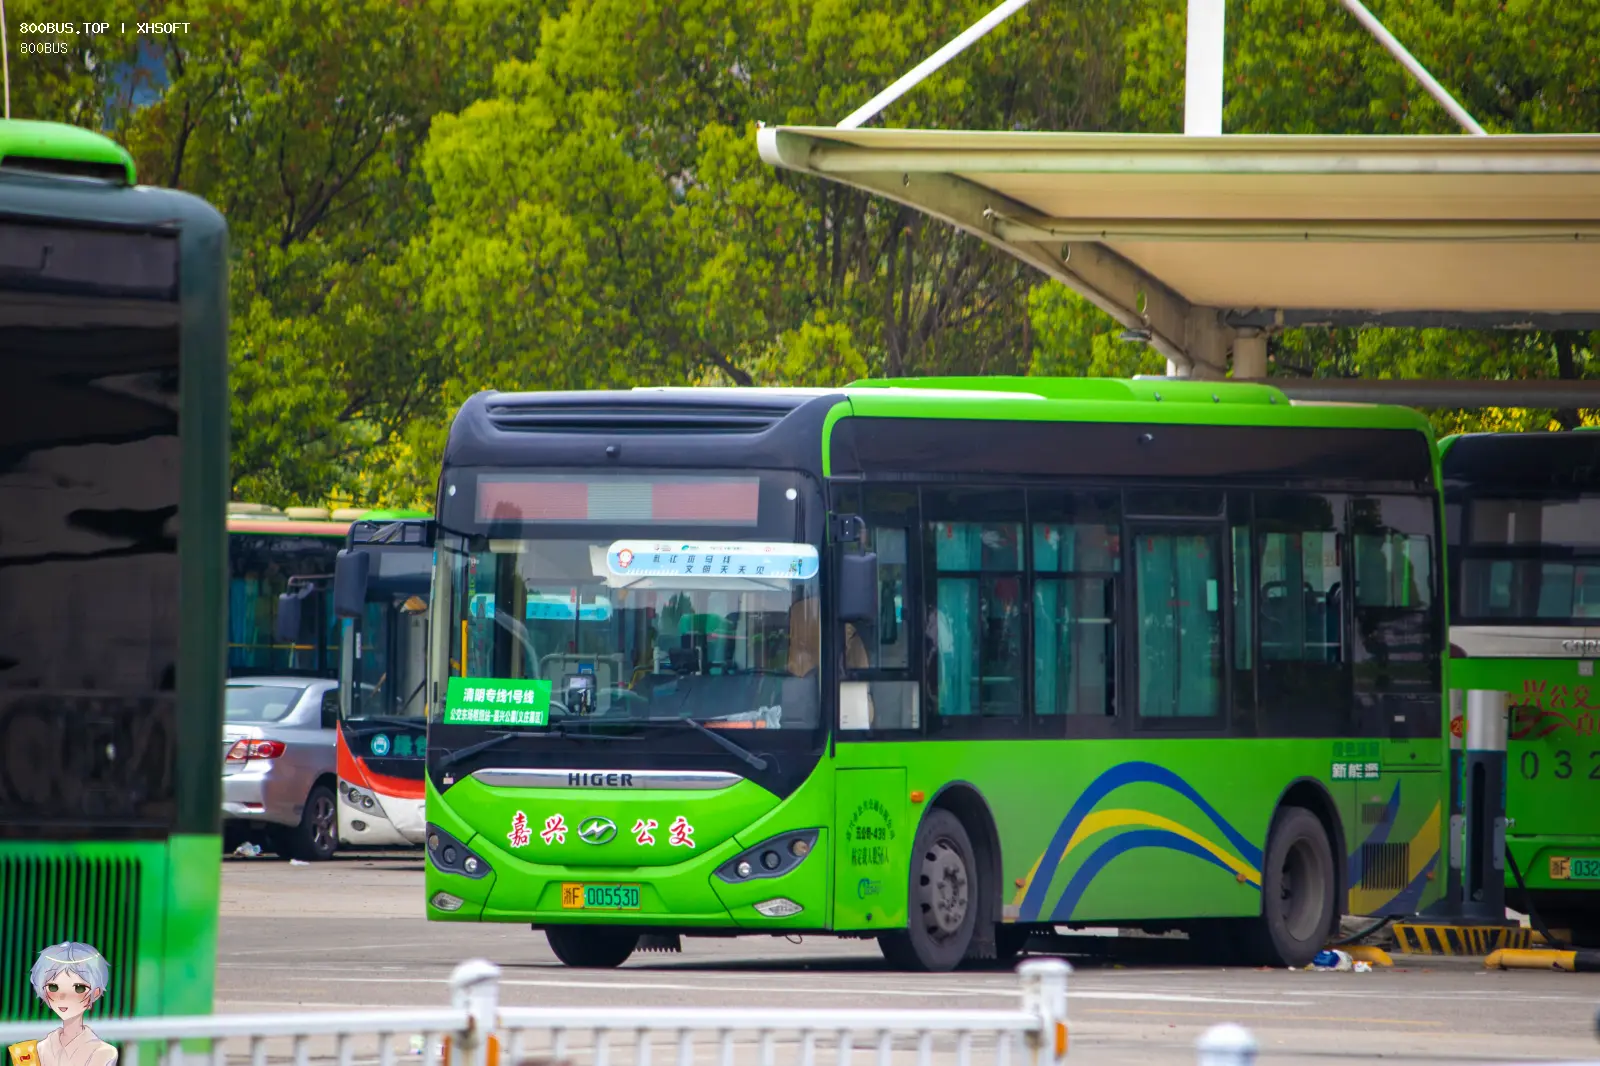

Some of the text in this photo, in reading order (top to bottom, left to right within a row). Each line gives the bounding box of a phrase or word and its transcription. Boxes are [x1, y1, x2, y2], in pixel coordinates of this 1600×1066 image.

[463, 687, 535, 705] 清明专线1号线
[1332, 763, 1379, 778] 新能源
[567, 772, 633, 787] HIGER
[506, 810, 697, 849] 嘉兴 公交
